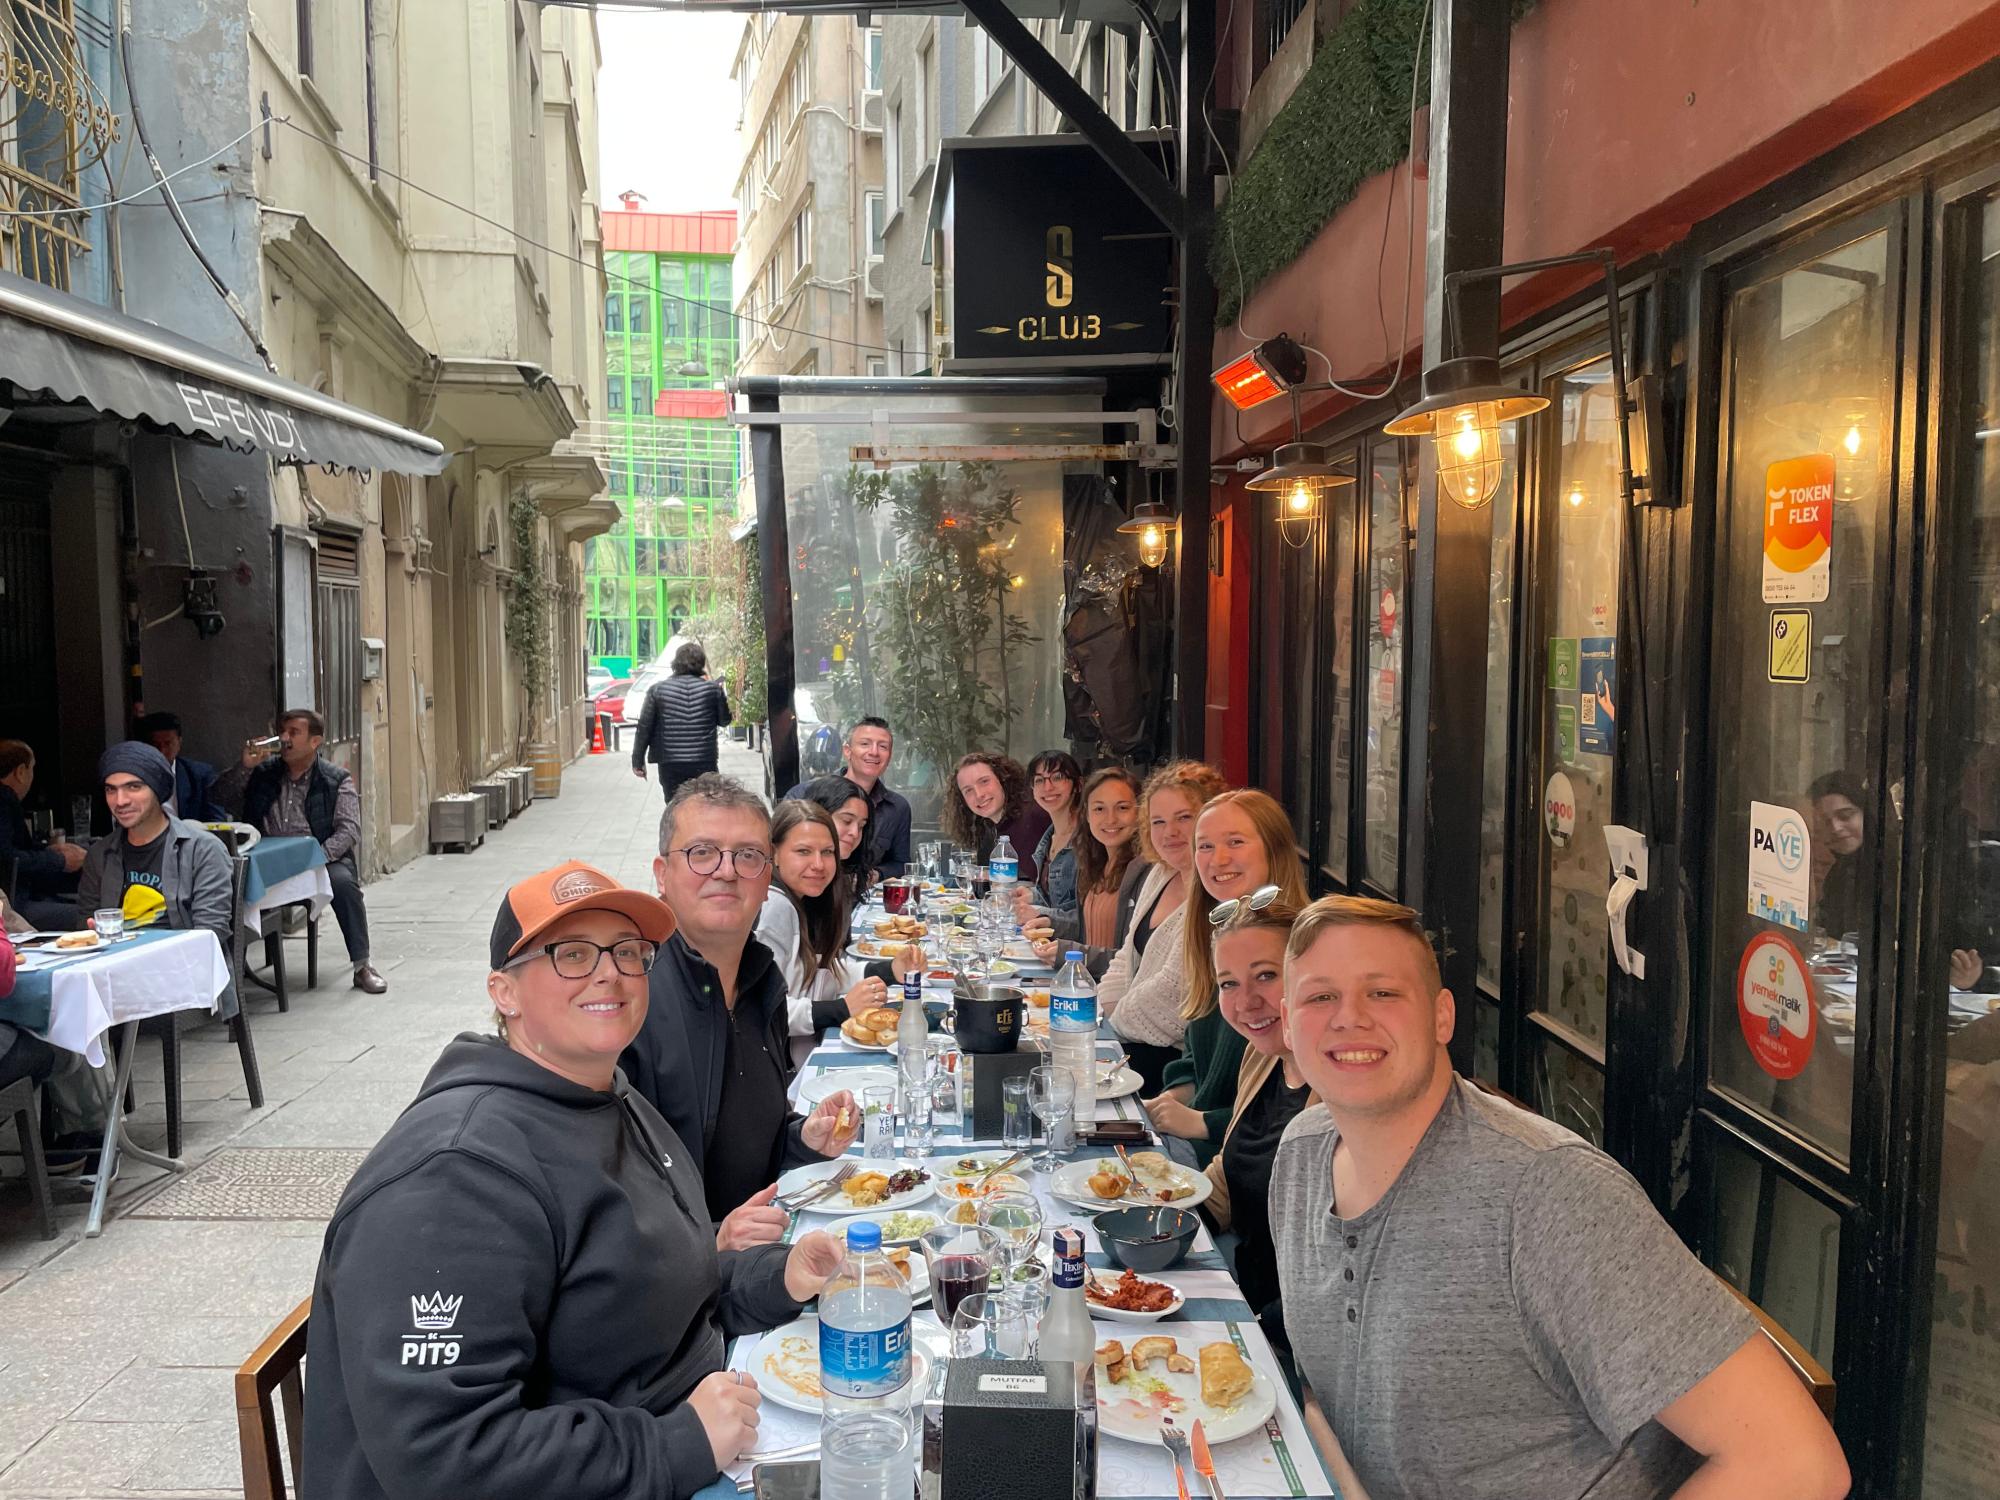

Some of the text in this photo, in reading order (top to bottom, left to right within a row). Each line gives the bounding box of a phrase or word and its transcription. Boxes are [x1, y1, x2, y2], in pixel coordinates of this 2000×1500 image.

[1018, 314, 1101, 341] CLUB
[1789, 484, 1831, 504] TOKEN
[1789, 506, 1819, 524] FLEX
[1053, 998, 1080, 1012] Erikli
[401, 1342, 461, 1366] PIT9
